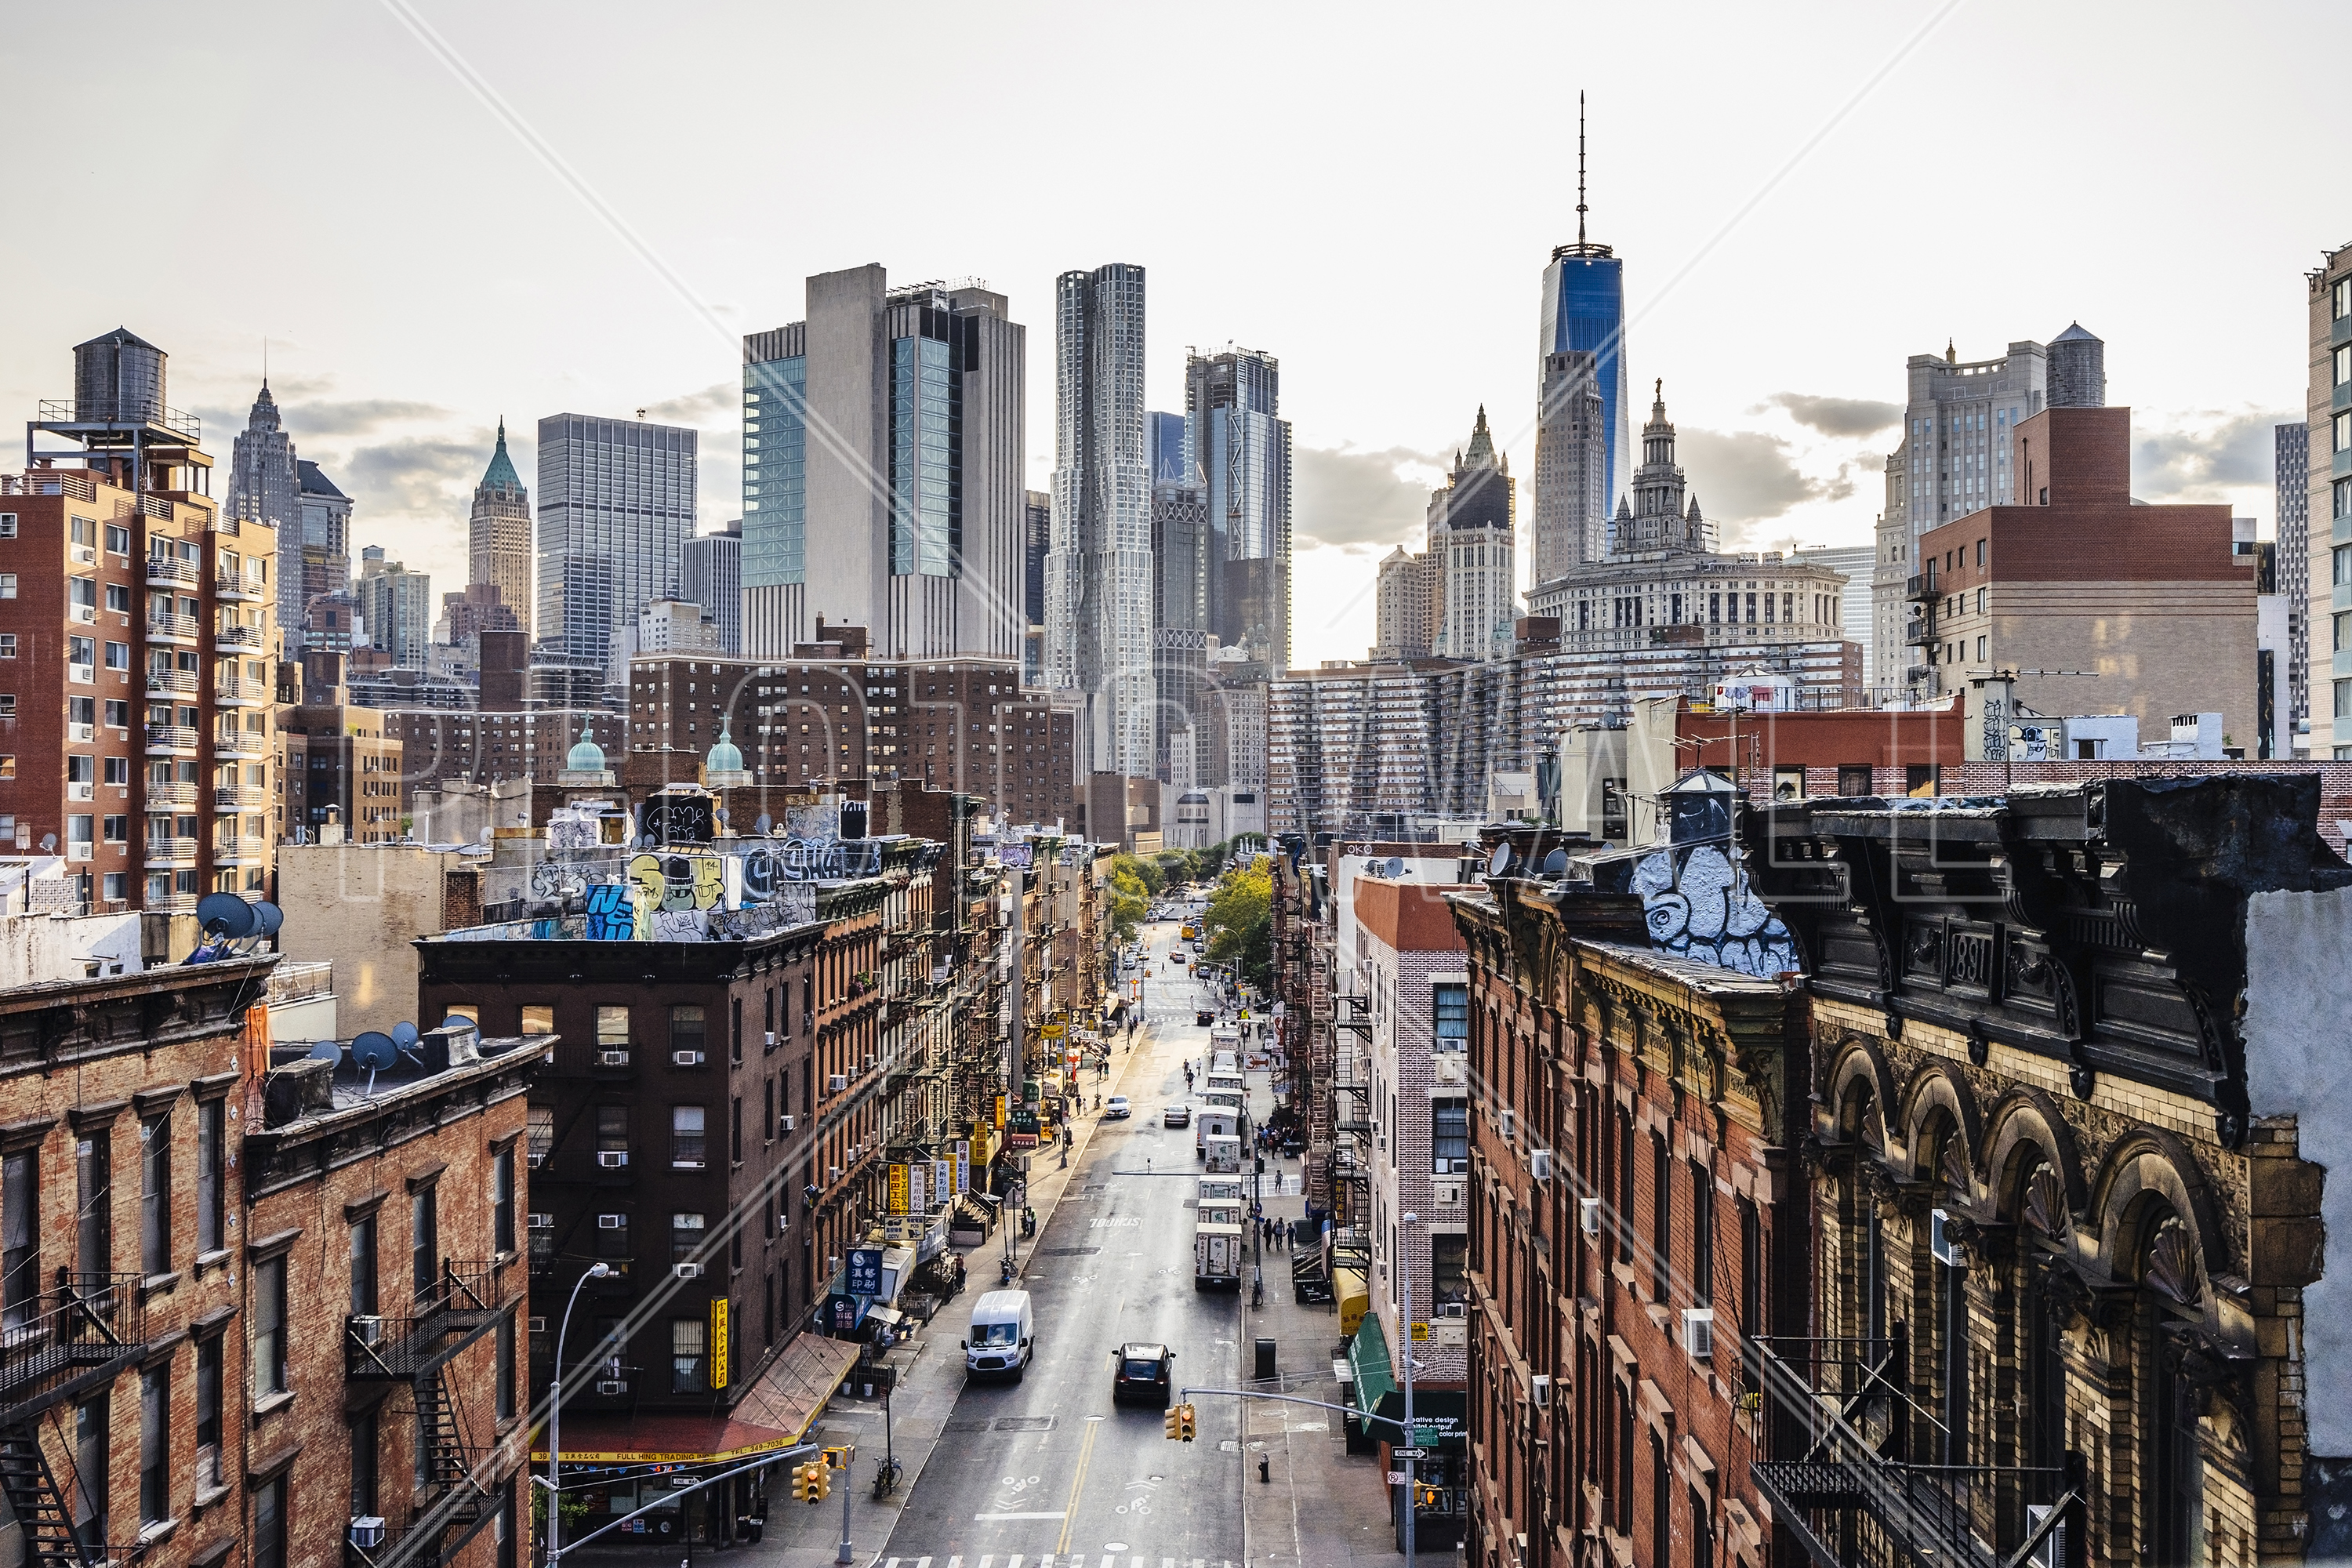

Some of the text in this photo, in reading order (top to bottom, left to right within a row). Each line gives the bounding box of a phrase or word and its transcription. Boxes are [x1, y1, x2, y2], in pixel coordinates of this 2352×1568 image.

[1347, 844, 1372, 855] OKO
[1951, 933, 1985, 985] 1891
[1089, 1217, 1142, 1229] SCHOOL
[750, 1439, 783, 1453] 349-7036
